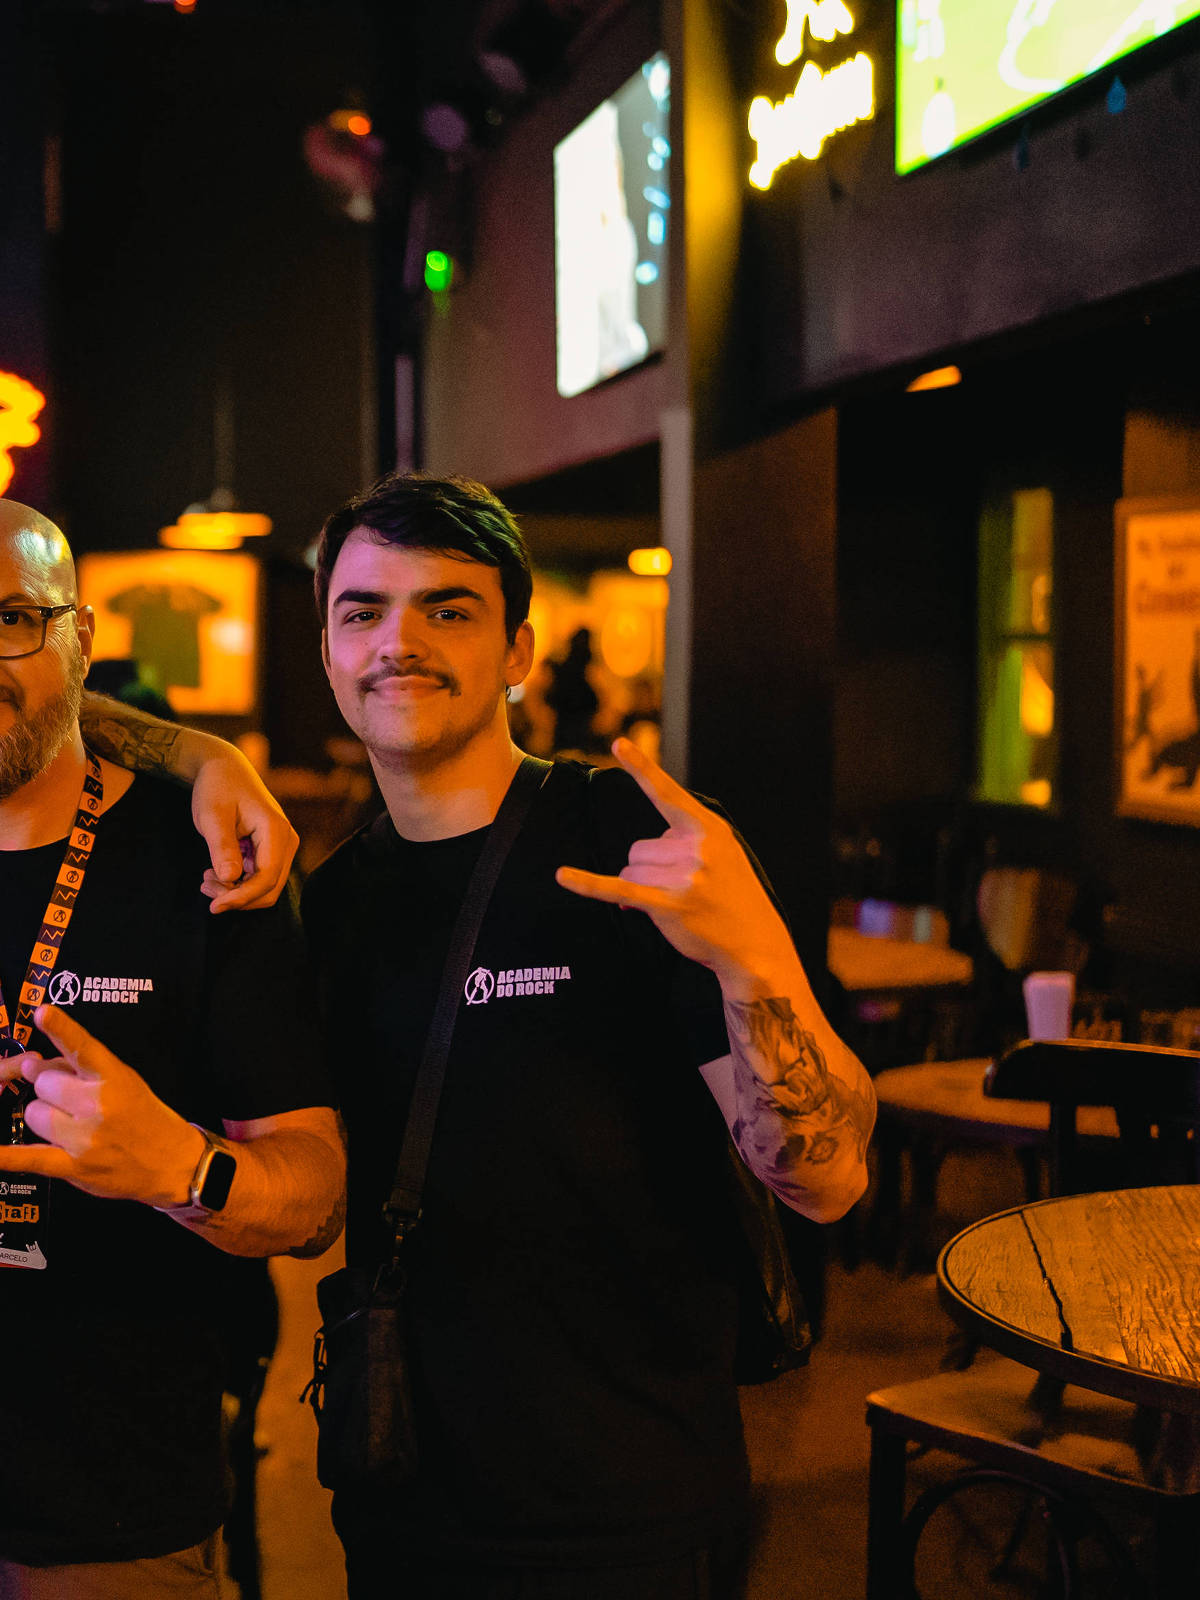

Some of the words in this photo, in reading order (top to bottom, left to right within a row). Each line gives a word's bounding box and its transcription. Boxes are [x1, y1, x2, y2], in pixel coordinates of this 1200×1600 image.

[497, 966, 571, 984] ACADEMIA
[83, 976, 154, 992] ACADEMIA
[496, 984, 514, 998] DO
[515, 981, 555, 996] ROCK
[82, 989, 101, 1003] DO
[101, 990, 139, 1004] ROCK
